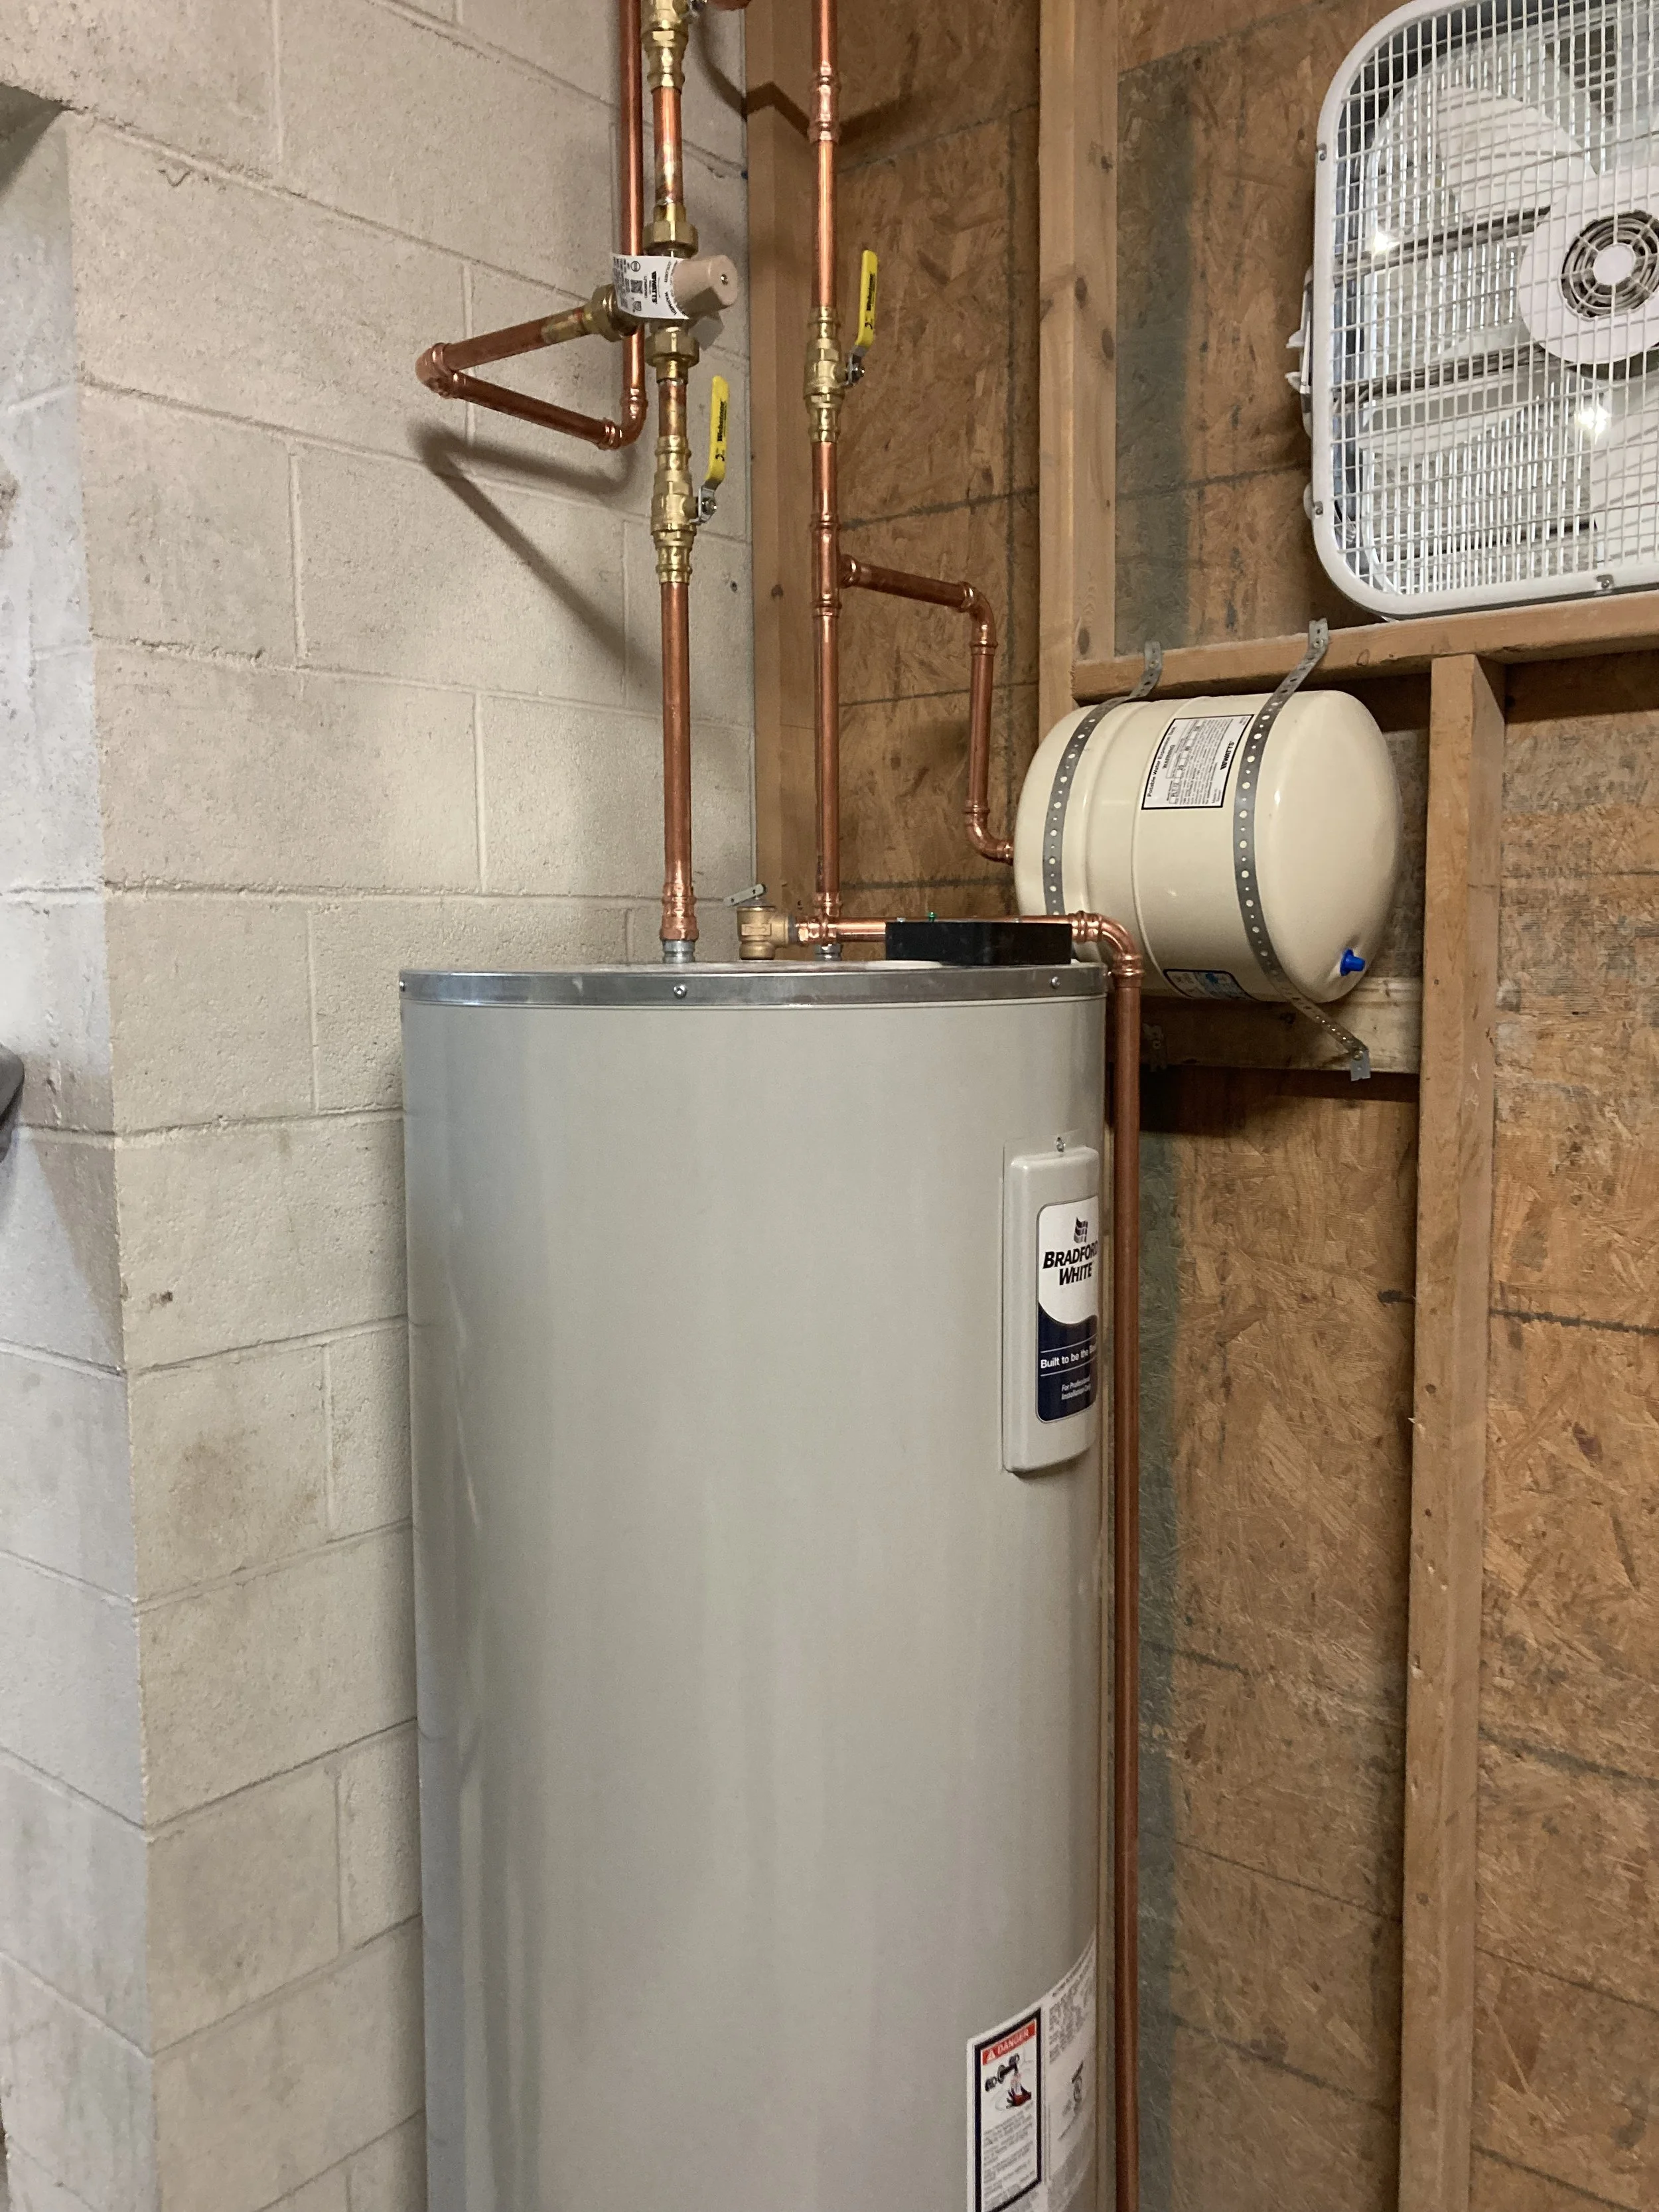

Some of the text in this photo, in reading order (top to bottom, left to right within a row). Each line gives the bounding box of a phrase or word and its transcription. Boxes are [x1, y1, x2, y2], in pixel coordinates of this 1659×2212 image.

[665, 291, 677, 316] WARMER
[1163, 745, 1175, 769] WARNING
[1222, 741, 1235, 763] WATTS
[1147, 776, 1156, 797] Potable
[1152, 761, 1161, 775] Water
[1059, 1262, 1093, 1286] WHITE
[1041, 1357, 1060, 1368] Built
[1062, 1355, 1070, 1364] to
[1070, 1353, 1080, 1362] be
[1080, 1349, 1089, 1358] the
[997, 2028, 1029, 2055] DANGER
